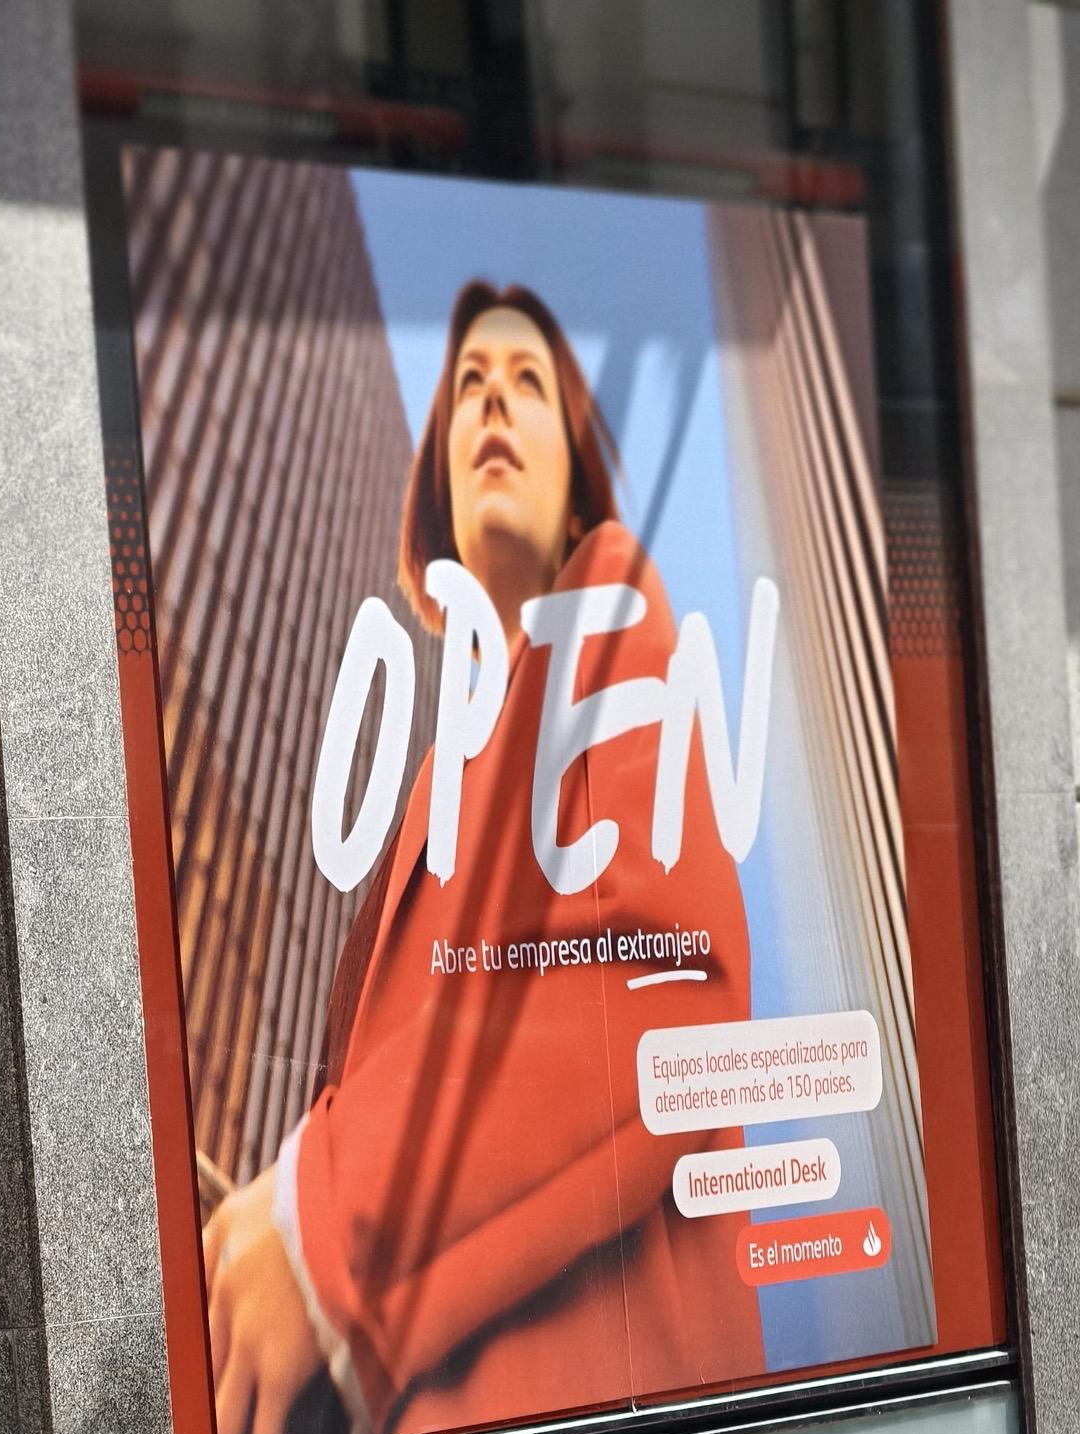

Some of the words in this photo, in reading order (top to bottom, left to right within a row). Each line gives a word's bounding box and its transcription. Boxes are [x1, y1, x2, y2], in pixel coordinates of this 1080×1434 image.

[311, 558, 779, 896] OPEN
[430, 938, 476, 975] Abre
[481, 939, 502, 971] tu
[507, 936, 591, 976] empresa
[596, 928, 613, 962] al
[617, 923, 711, 967] extranjero
[652, 1052, 703, 1084] Equipos
[706, 1048, 748, 1075] locales
[751, 1038, 838, 1072] especializados
[841, 1039, 868, 1067] para
[655, 1087, 717, 1113] atenderte
[720, 1088, 737, 1106] en
[739, 1079, 766, 1104] más
[769, 1077, 784, 1100] de
[787, 1074, 811, 1099] 150
[814, 1072, 855, 1103] países.
[688, 1160, 787, 1198] International
[791, 1156, 827, 1185] Desk
[749, 1243, 765, 1268] Es
[767, 1239, 778, 1265] el
[781, 1234, 843, 1262] momento
